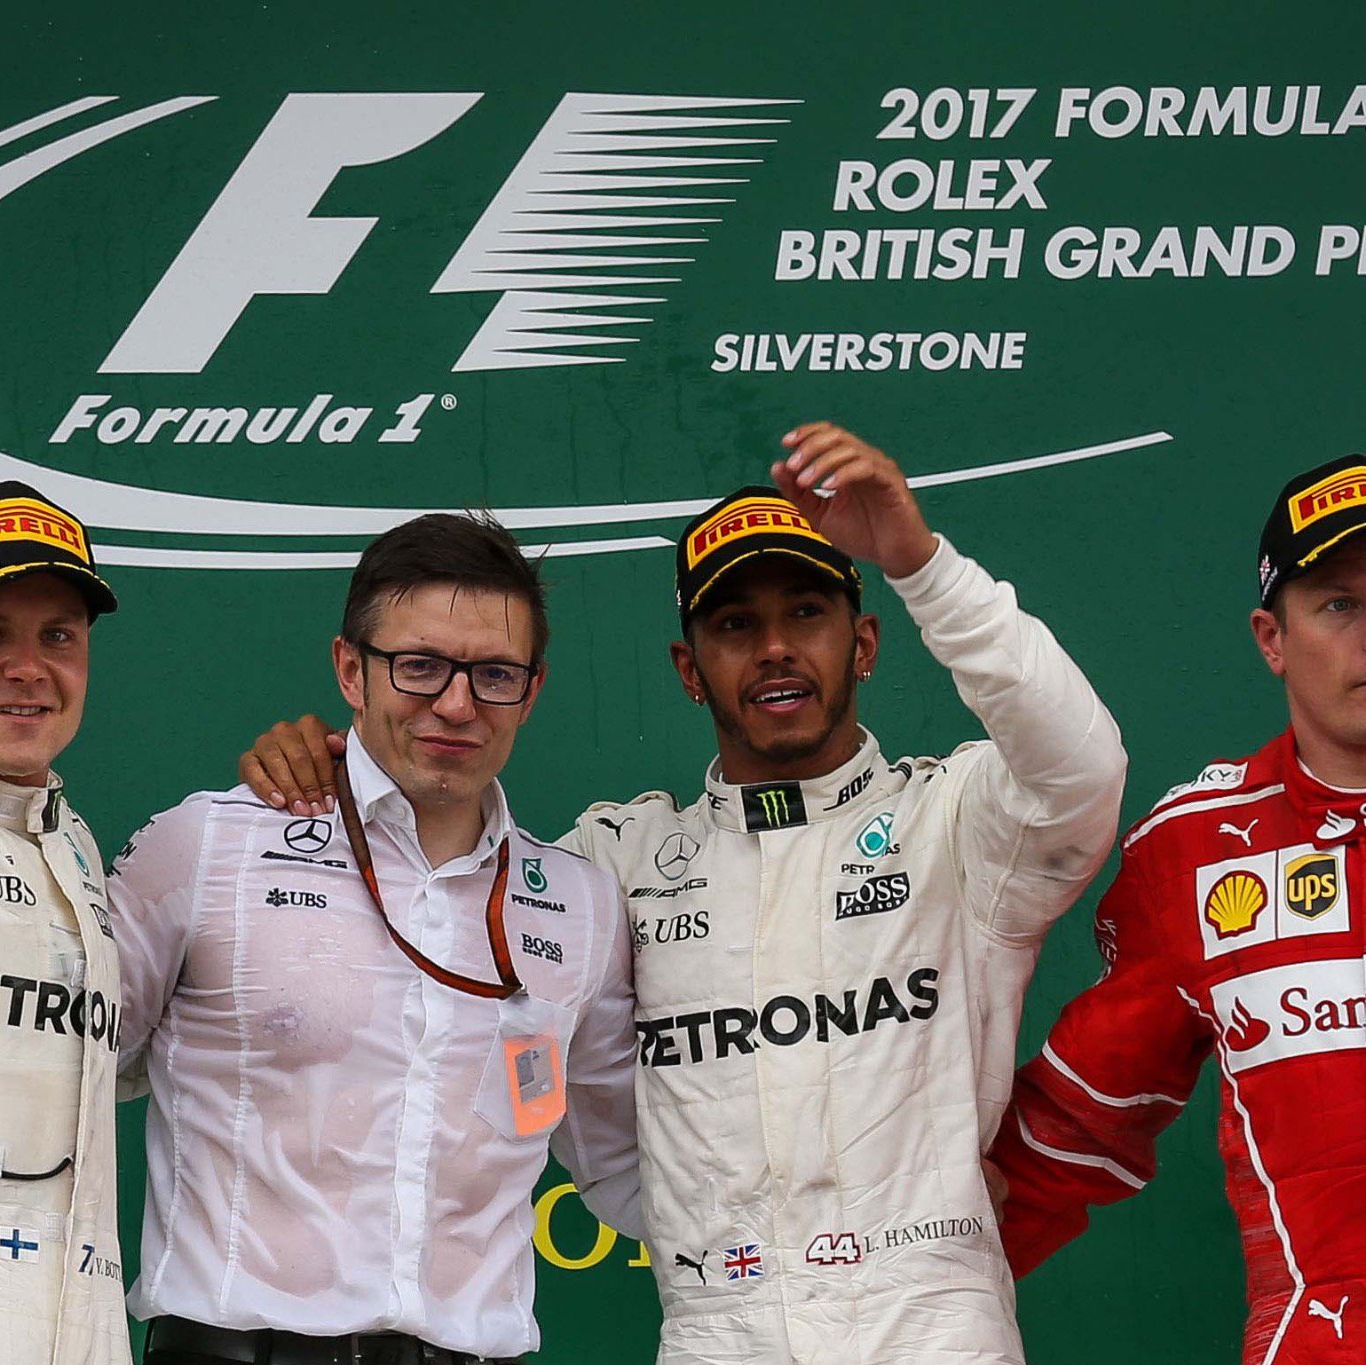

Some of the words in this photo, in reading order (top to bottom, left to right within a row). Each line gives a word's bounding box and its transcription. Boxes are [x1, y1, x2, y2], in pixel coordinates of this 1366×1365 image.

[875, 87, 1037, 139] 2017
[833, 158, 1052, 212] ROLEX
[773, 227, 1026, 282] BRITISH
[1044, 225, 1296, 280] GRAND
[709, 331, 1027, 373] SILVERSTONE
[48, 393, 373, 445] Formula
[693, 504, 819, 557] PIRELL
[289, 891, 328, 909] UBS
[511, 893, 566, 913] PETRONAS
[1287, 869, 1337, 911] ups
[521, 932, 563, 958] BOSS
[654, 911, 711, 945] UBS
[805, 1231, 861, 1266] 44
[884, 1215, 985, 1250] HAMILTON
